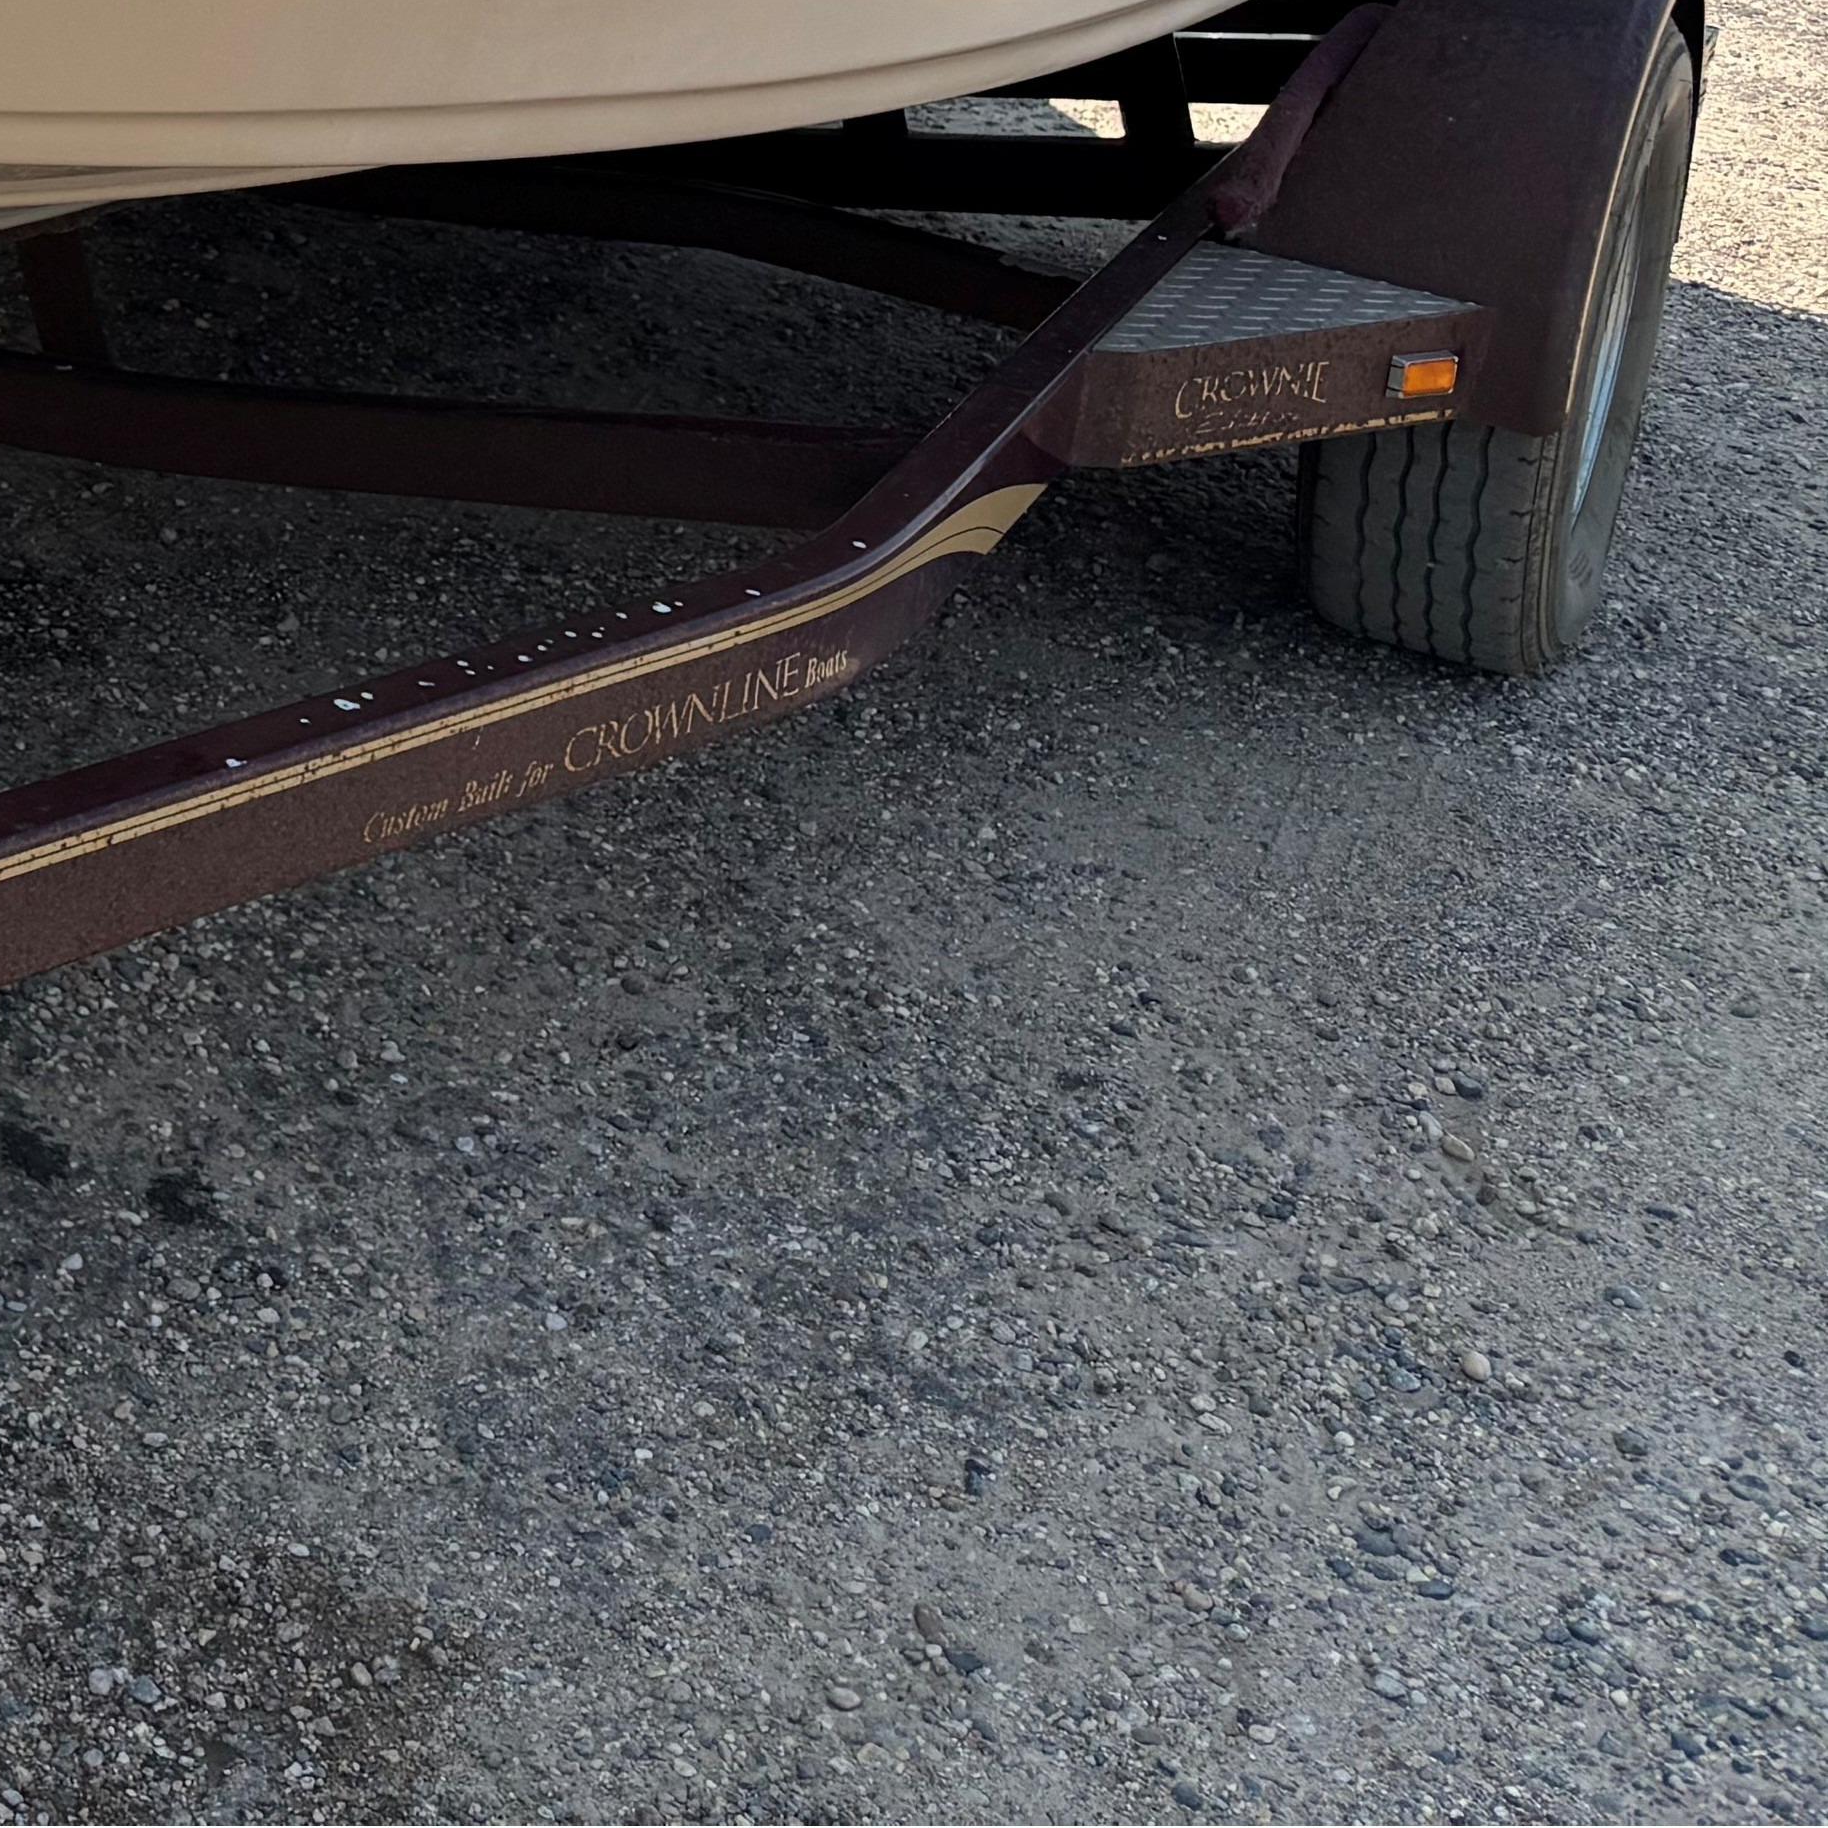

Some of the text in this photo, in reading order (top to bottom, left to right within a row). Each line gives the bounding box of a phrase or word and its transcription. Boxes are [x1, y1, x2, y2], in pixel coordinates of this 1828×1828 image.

[362, 797, 450, 844] Custom
[515, 760, 554, 798] for
[563, 651, 801, 774] CROWNLINE
[804, 649, 848, 689] Boats
